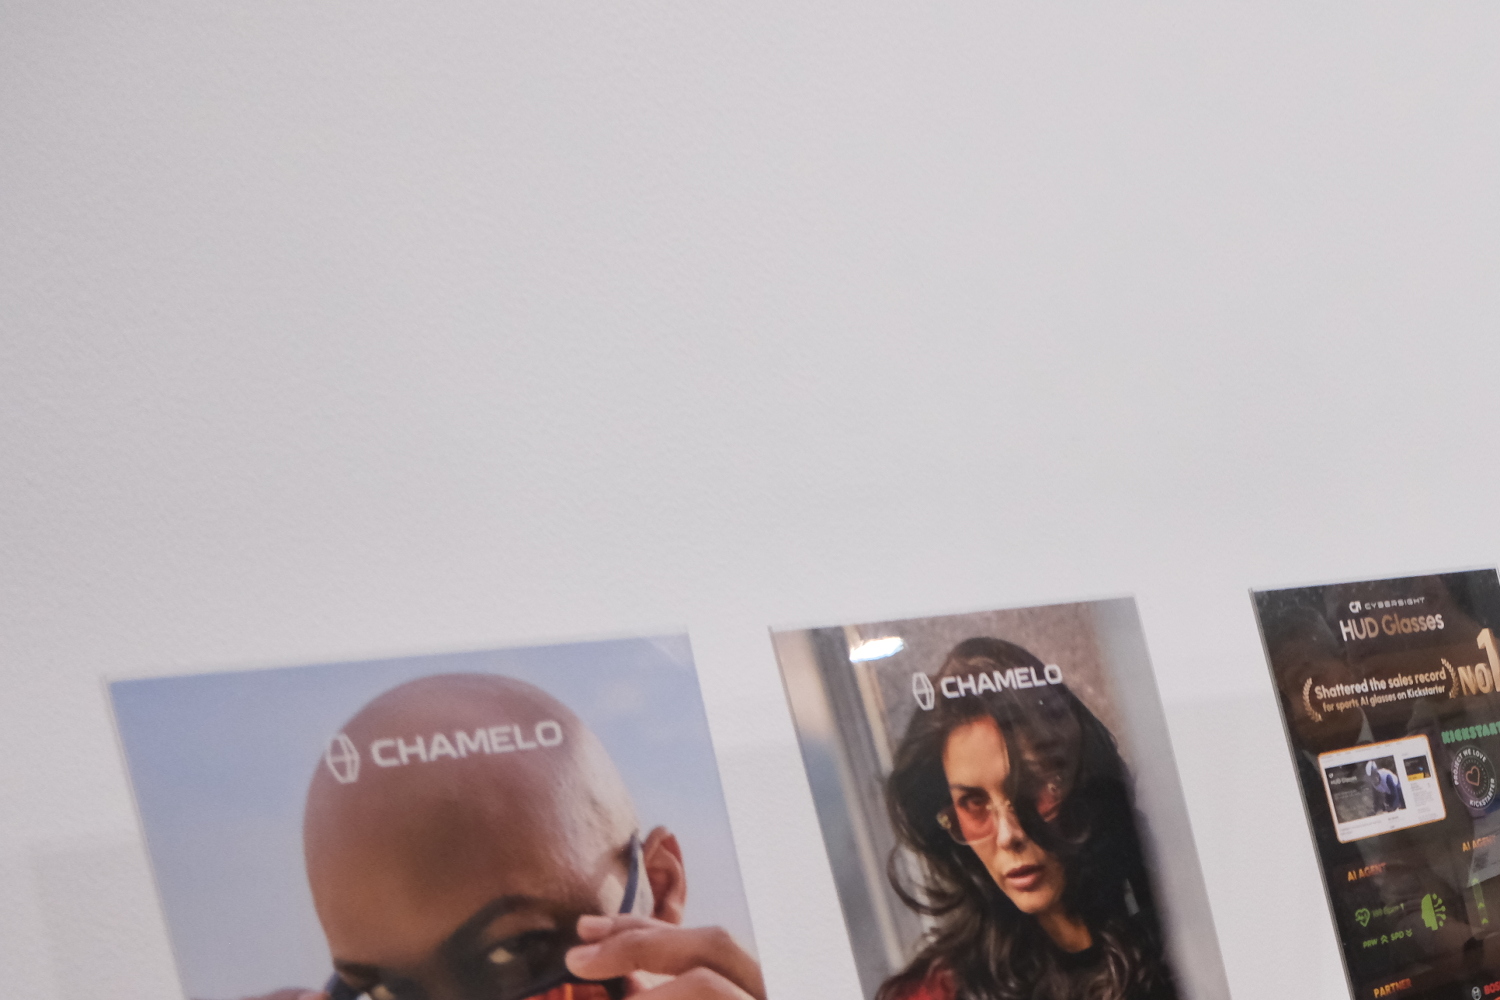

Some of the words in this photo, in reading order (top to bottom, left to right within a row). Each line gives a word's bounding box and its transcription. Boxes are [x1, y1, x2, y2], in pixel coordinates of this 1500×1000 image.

[1364, 597, 1425, 610] CYBERSIGHT
[1339, 617, 1379, 642] HUD
[1381, 613, 1444, 636] Glasses
[940, 664, 1063, 699] CHAMELO
[1314, 678, 1369, 699] Shattered
[1369, 677, 1387, 691] the
[1388, 673, 1413, 688] sales
[1415, 667, 1447, 684] record
[1323, 701, 1334, 712] for
[1336, 699, 1359, 712] sports
[1360, 696, 1369, 706] AI
[1369, 693, 1396, 707] glasses
[1397, 690, 1407, 700] on
[1407, 685, 1445, 699] Kickstarter
[371, 720, 563, 768] CHAMELO
[1463, 748, 1471, 756] WE
[1472, 749, 1486, 762] LOVE
[1373, 978, 1412, 998] PARTNER
